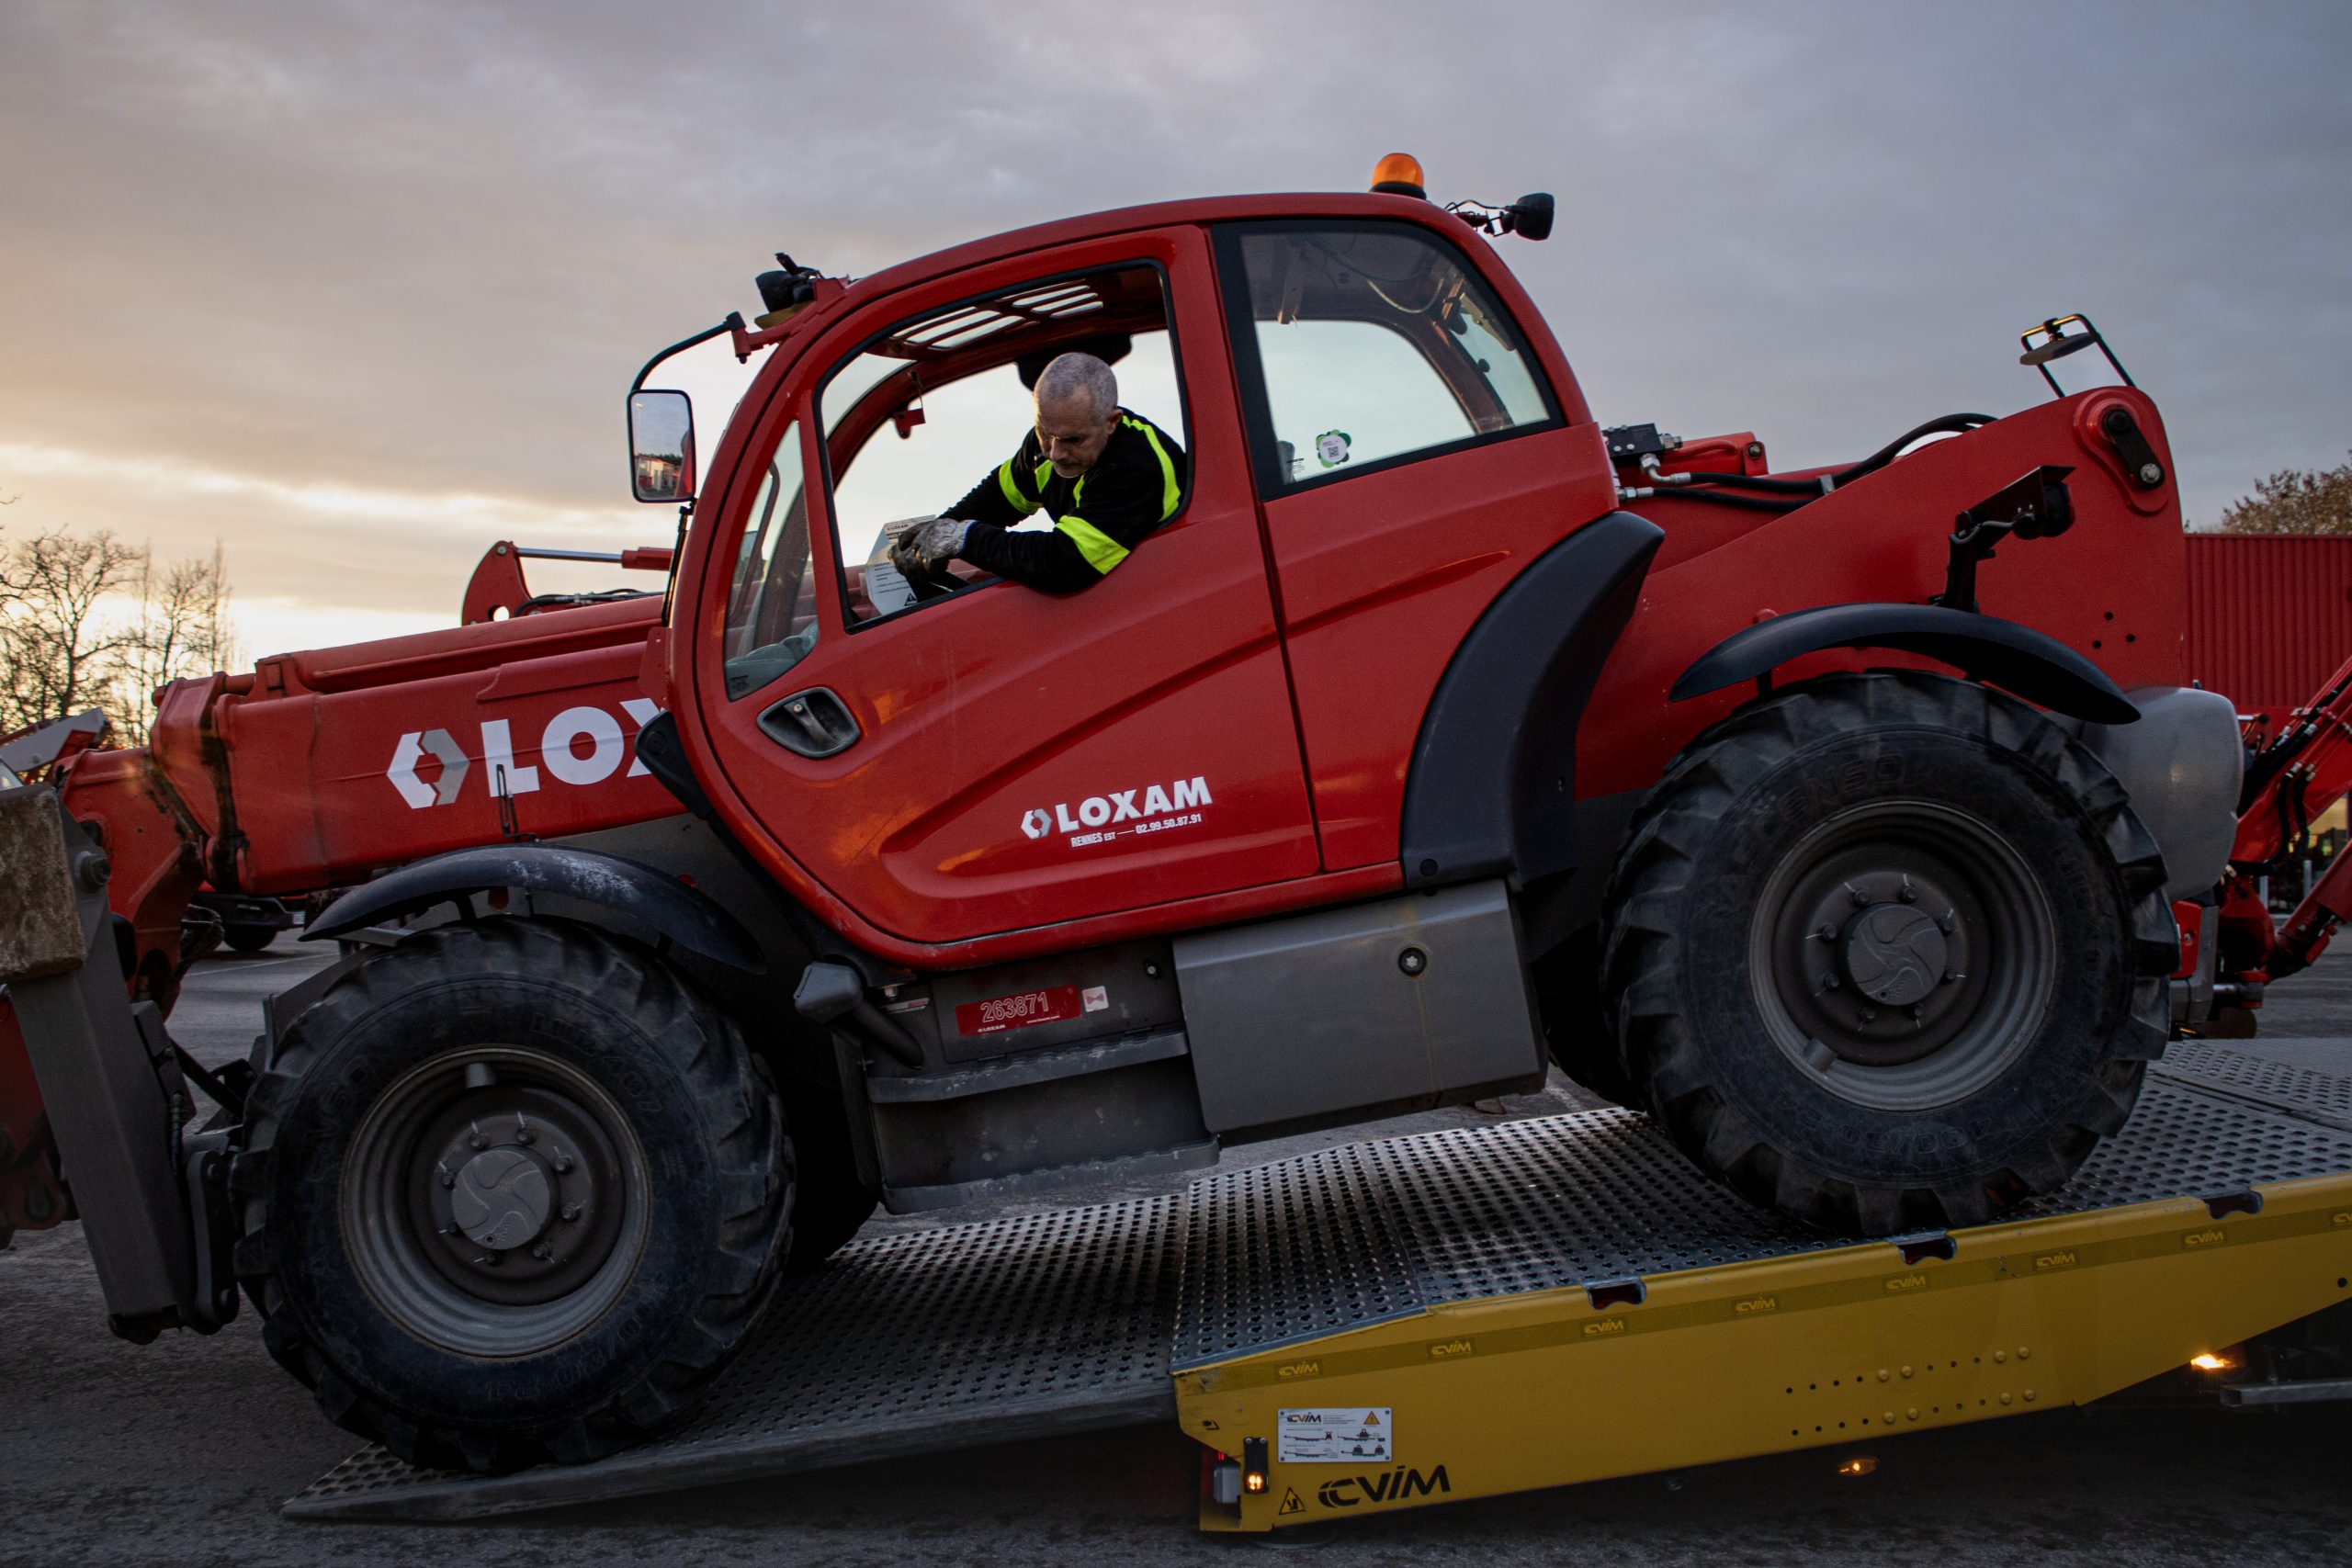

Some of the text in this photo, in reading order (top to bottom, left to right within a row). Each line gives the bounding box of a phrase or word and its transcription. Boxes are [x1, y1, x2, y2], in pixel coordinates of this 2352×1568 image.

[1055, 776, 1214, 833] LOXAM
[1070, 813, 1203, 848] RENNES EST 02.99.50.87.91
[979, 991, 1049, 1023] 263871
[1286, 1412, 1322, 1423] CVIM
[1317, 1464, 1451, 1508] CVIM
